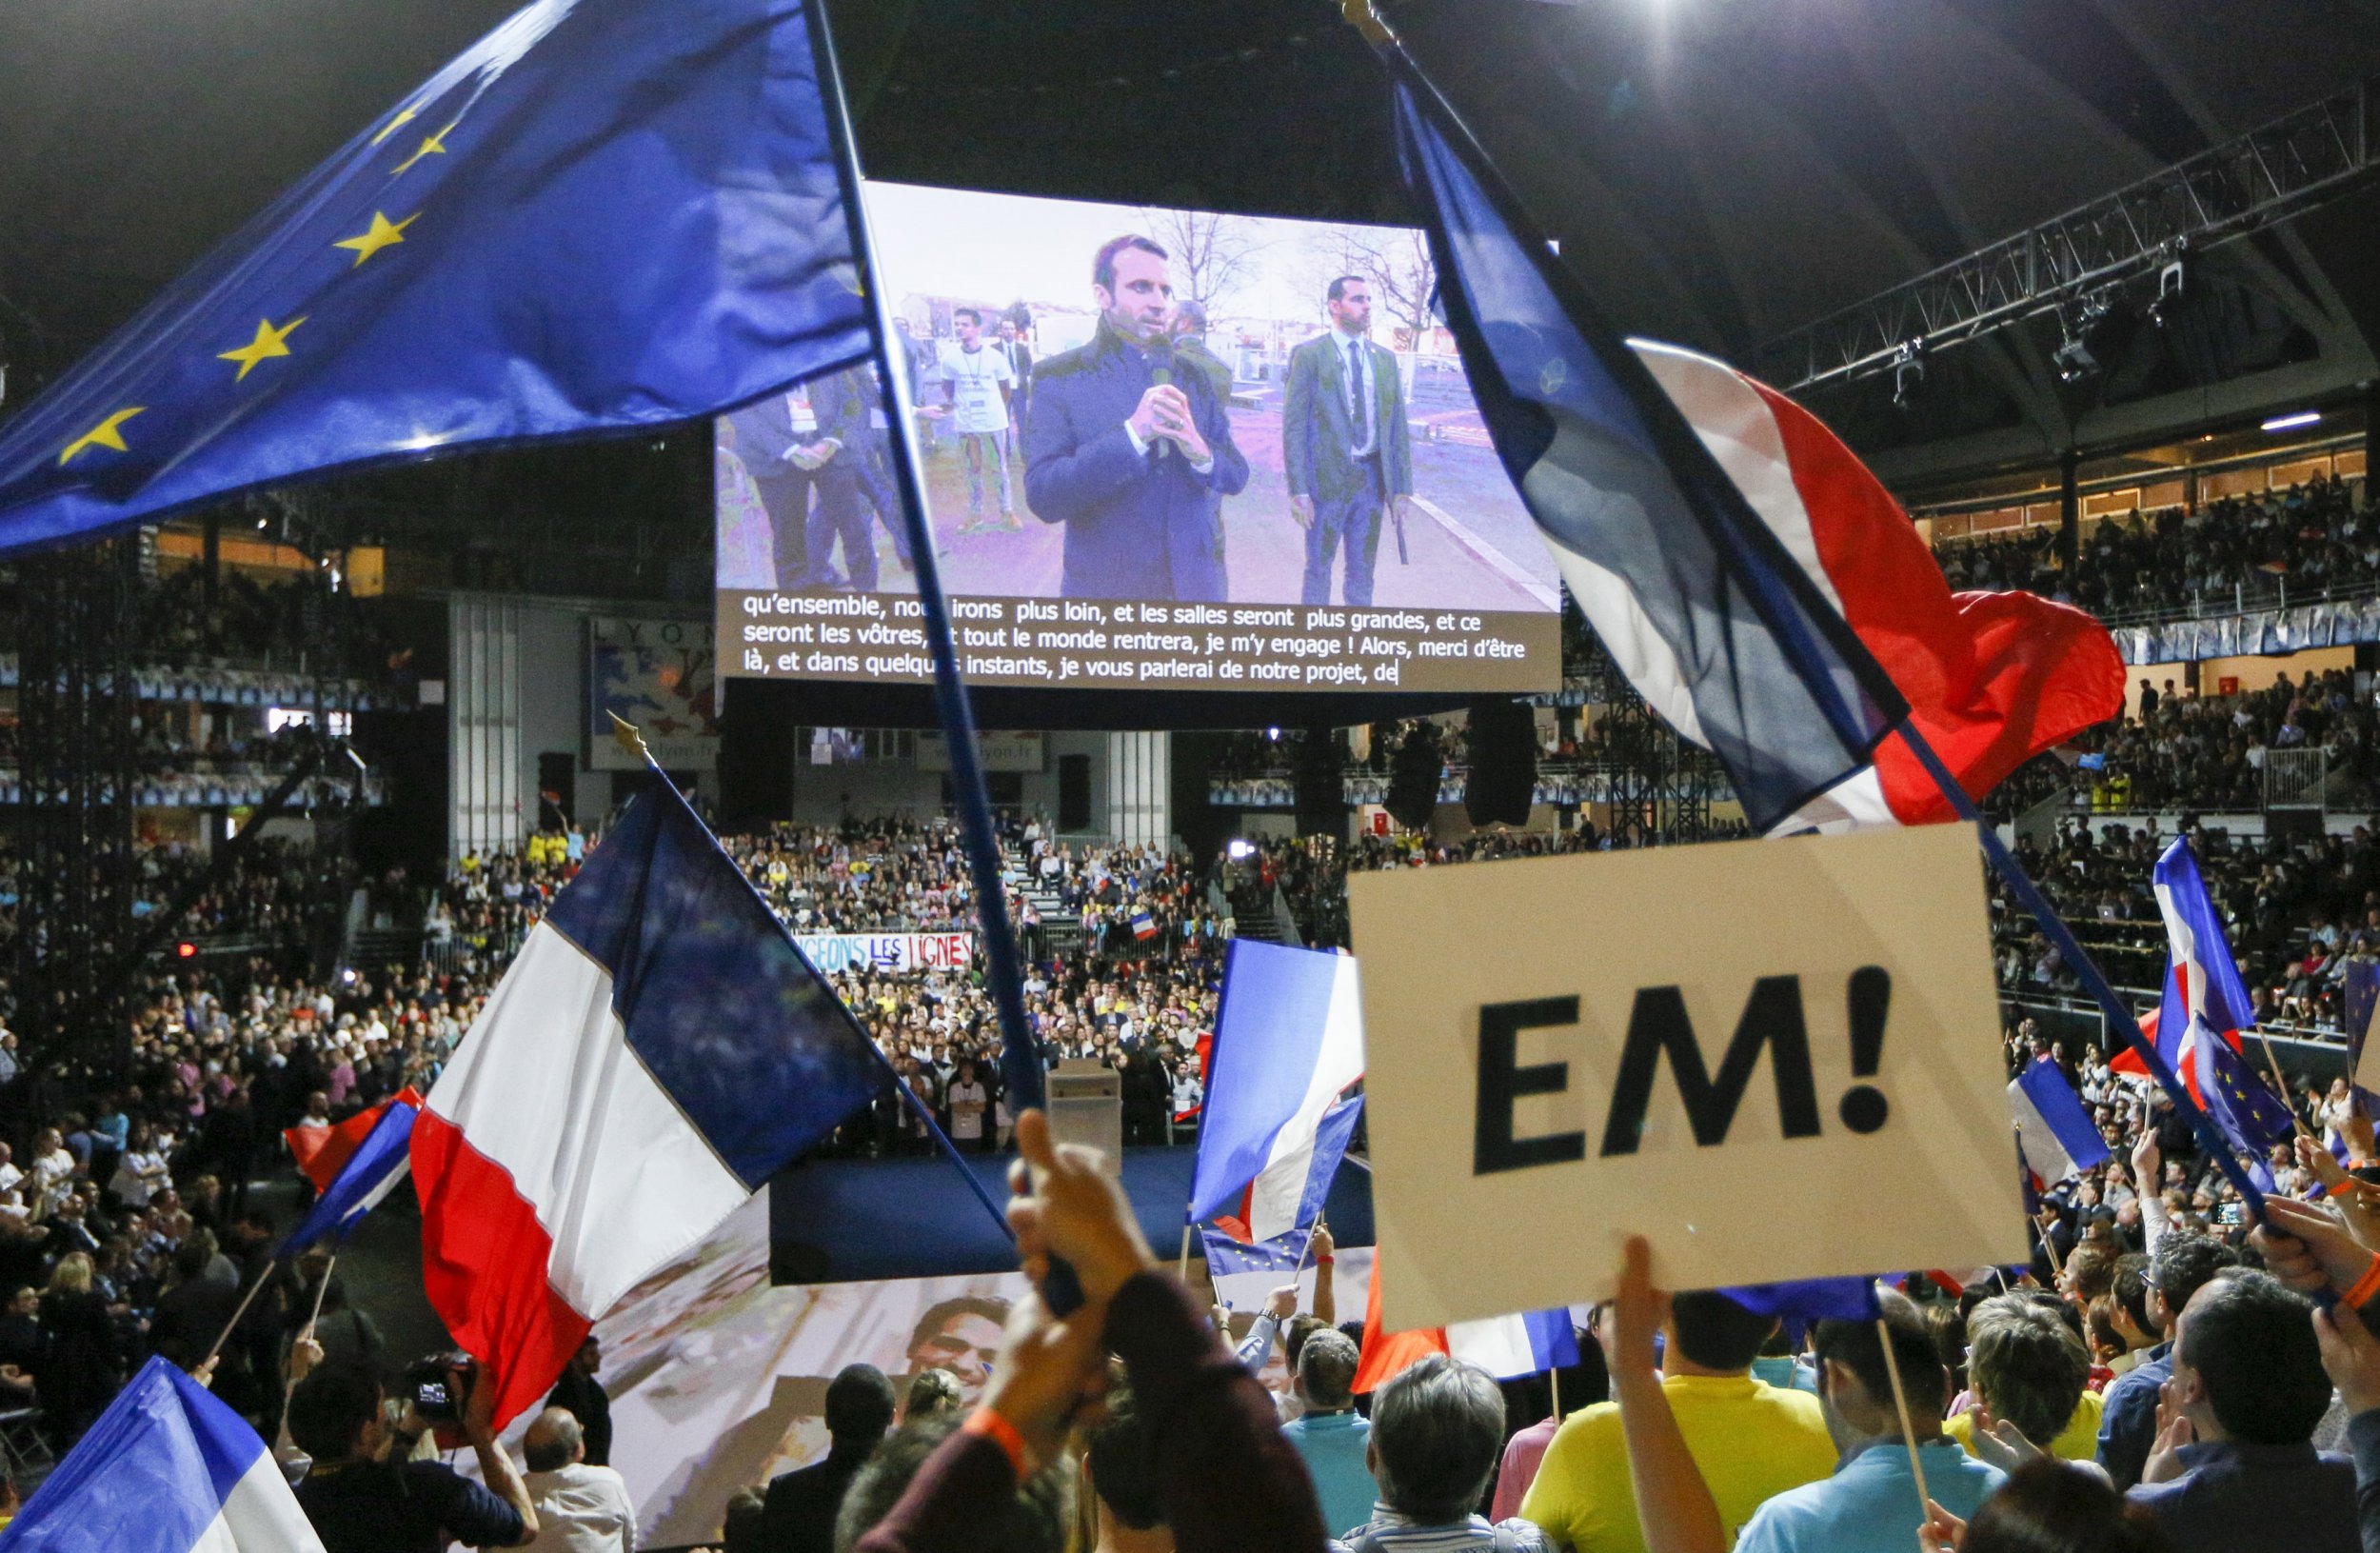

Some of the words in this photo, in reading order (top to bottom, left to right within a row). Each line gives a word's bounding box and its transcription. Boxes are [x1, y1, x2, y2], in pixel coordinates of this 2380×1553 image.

[951, 598, 1003, 620] irons
[1016, 599, 1060, 625] plus
[1064, 600, 1107, 627] loin,
[1113, 603, 1135, 623] et
[1140, 602, 1169, 624] les
[1173, 604, 1228, 626] salles
[1232, 607, 1296, 627] seront
[1306, 607, 1346, 631] plus
[1350, 609, 1431, 634] grandes,
[1435, 612, 1457, 631] et
[1459, 615, 1481, 632] ce
[743, 623, 815, 644] seront
[820, 622, 851, 645] les
[856, 622, 928, 650] vôtres,
[962, 627, 1008, 647] tout
[1012, 627, 1032, 648] le
[1037, 628, 1107, 650] monde
[1113, 631, 1200, 656] rentrera,
[1203, 631, 1225, 656] je
[1270, 637, 1341, 659] engage
[1347, 635, 1355, 655] !
[1359, 635, 1413, 660] Alors,
[1418, 638, 1469, 658] merci
[744, 647, 770, 675] là,
[777, 651, 801, 672] et
[805, 650, 860, 673] dans
[966, 653, 1054, 680] instants,
[1058, 656, 1081, 681] je
[1084, 660, 1135, 677] vous
[1140, 657, 1214, 682] parlerai
[1218, 659, 1244, 679] de
[1249, 661, 1301, 680] notre
[1305, 662, 1368, 686] projet,
[870, 937, 902, 960] LES
[1473, 964, 1892, 1177] EM!
